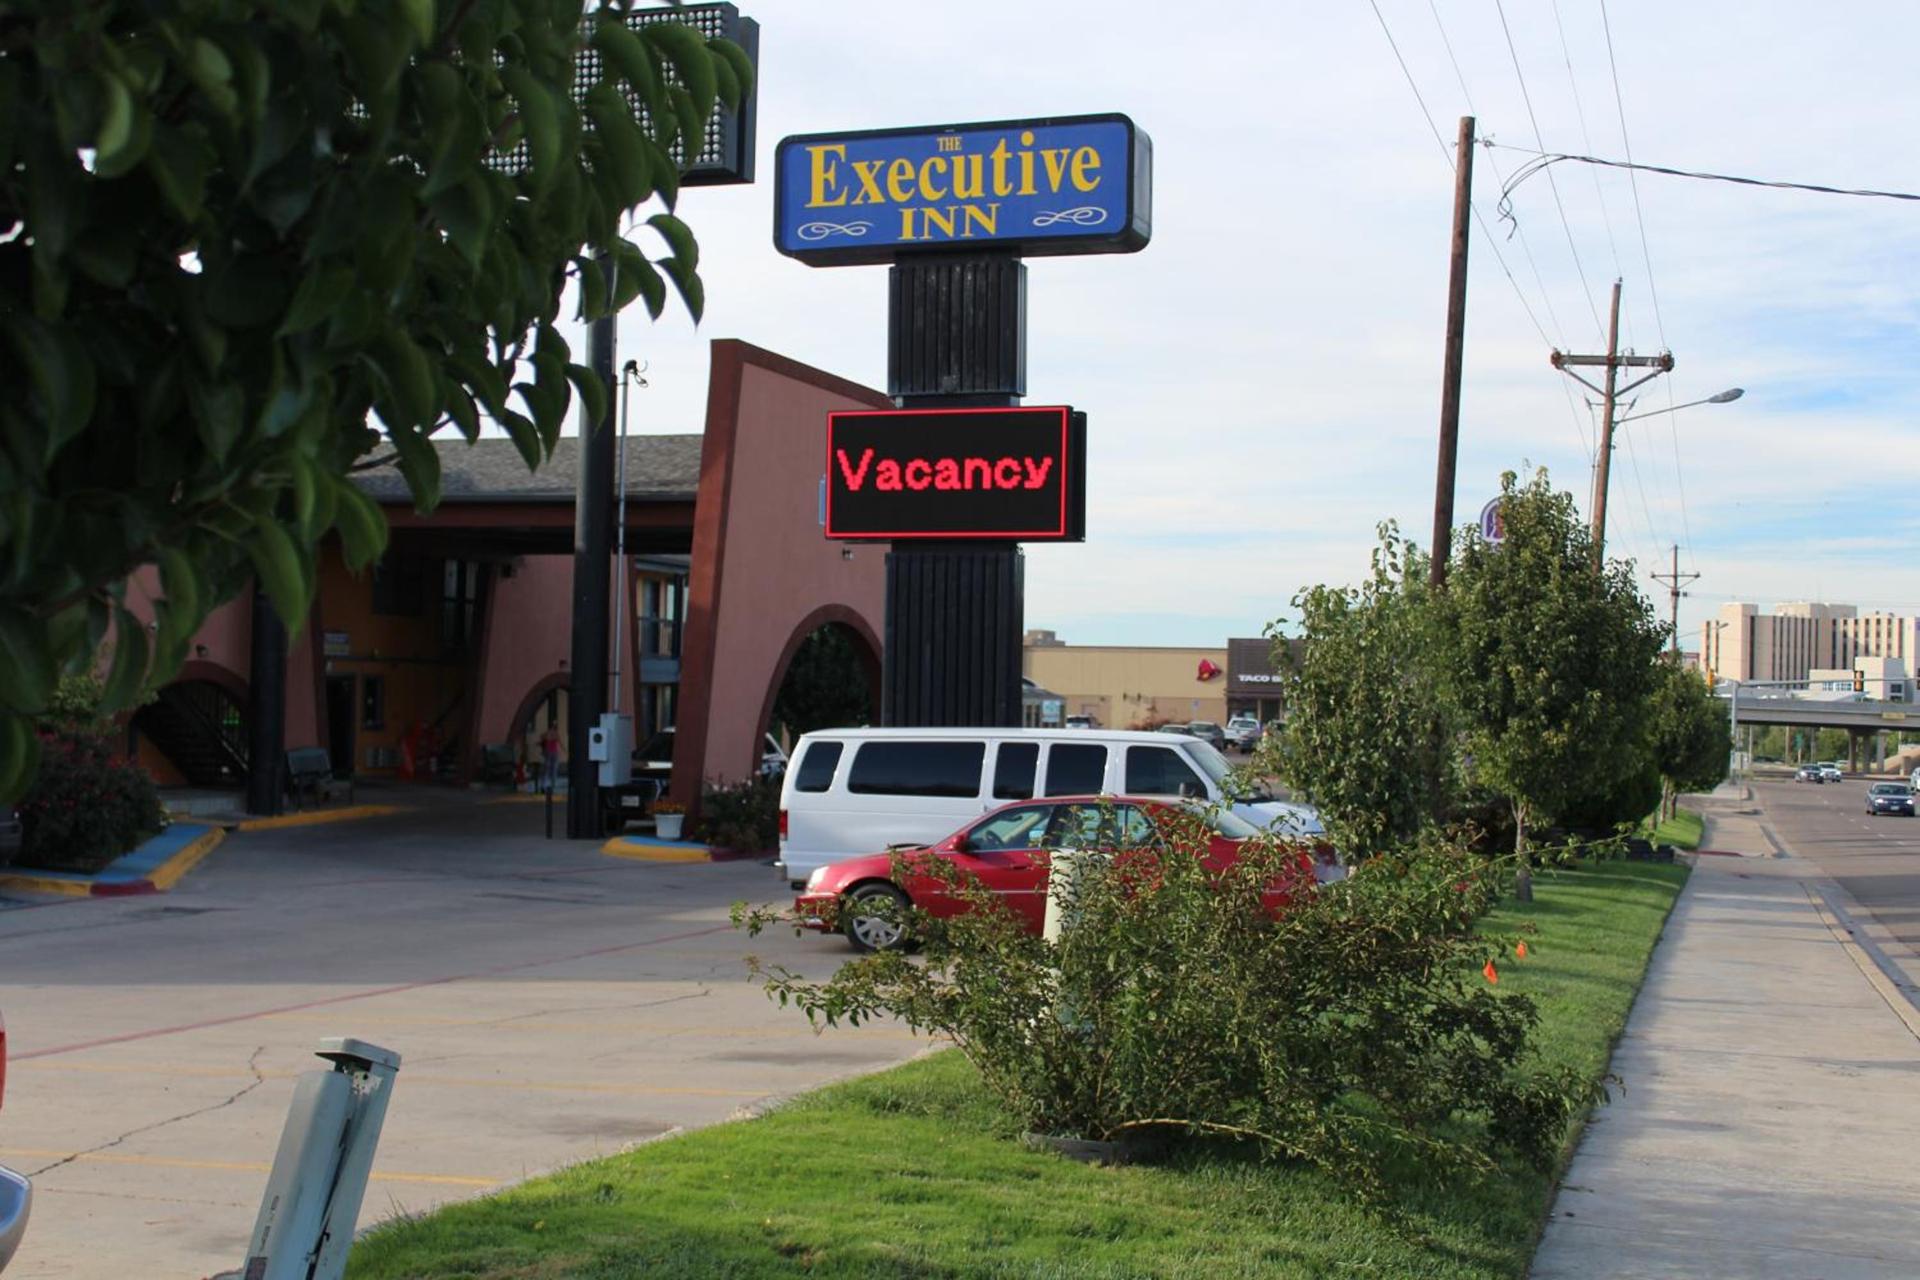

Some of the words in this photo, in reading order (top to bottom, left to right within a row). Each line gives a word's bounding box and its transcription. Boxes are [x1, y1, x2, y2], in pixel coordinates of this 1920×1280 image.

[937, 136, 962, 152] THE
[805, 131, 1101, 208] Executive
[897, 203, 1001, 240] INN
[836, 448, 1053, 491] Vacancy
[1238, 674, 1271, 683] TACO
